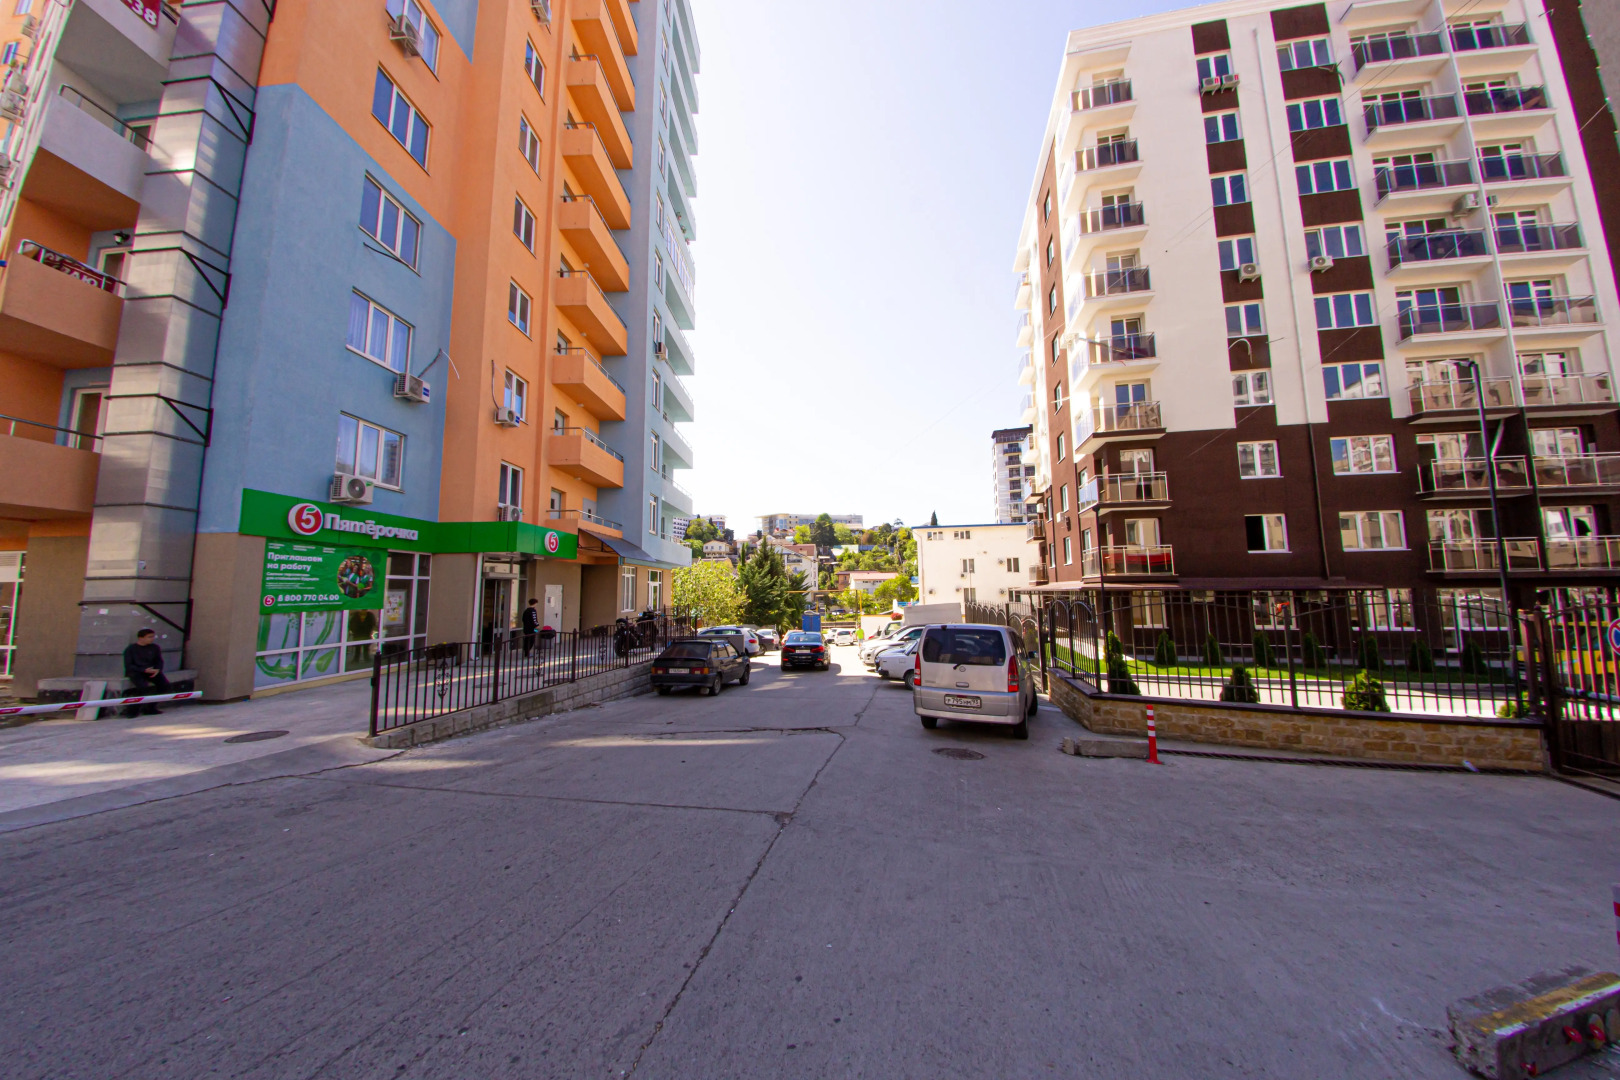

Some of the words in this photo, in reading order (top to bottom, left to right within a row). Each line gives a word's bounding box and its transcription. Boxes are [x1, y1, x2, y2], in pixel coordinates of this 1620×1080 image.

[323, 512, 419, 540] Пятёрочка
[267, 551, 323, 562] Приглашаем
[280, 563, 311, 572] работу
[277, 594, 283, 602] 8
[284, 594, 301, 602] 800
[303, 594, 317, 602] 770
